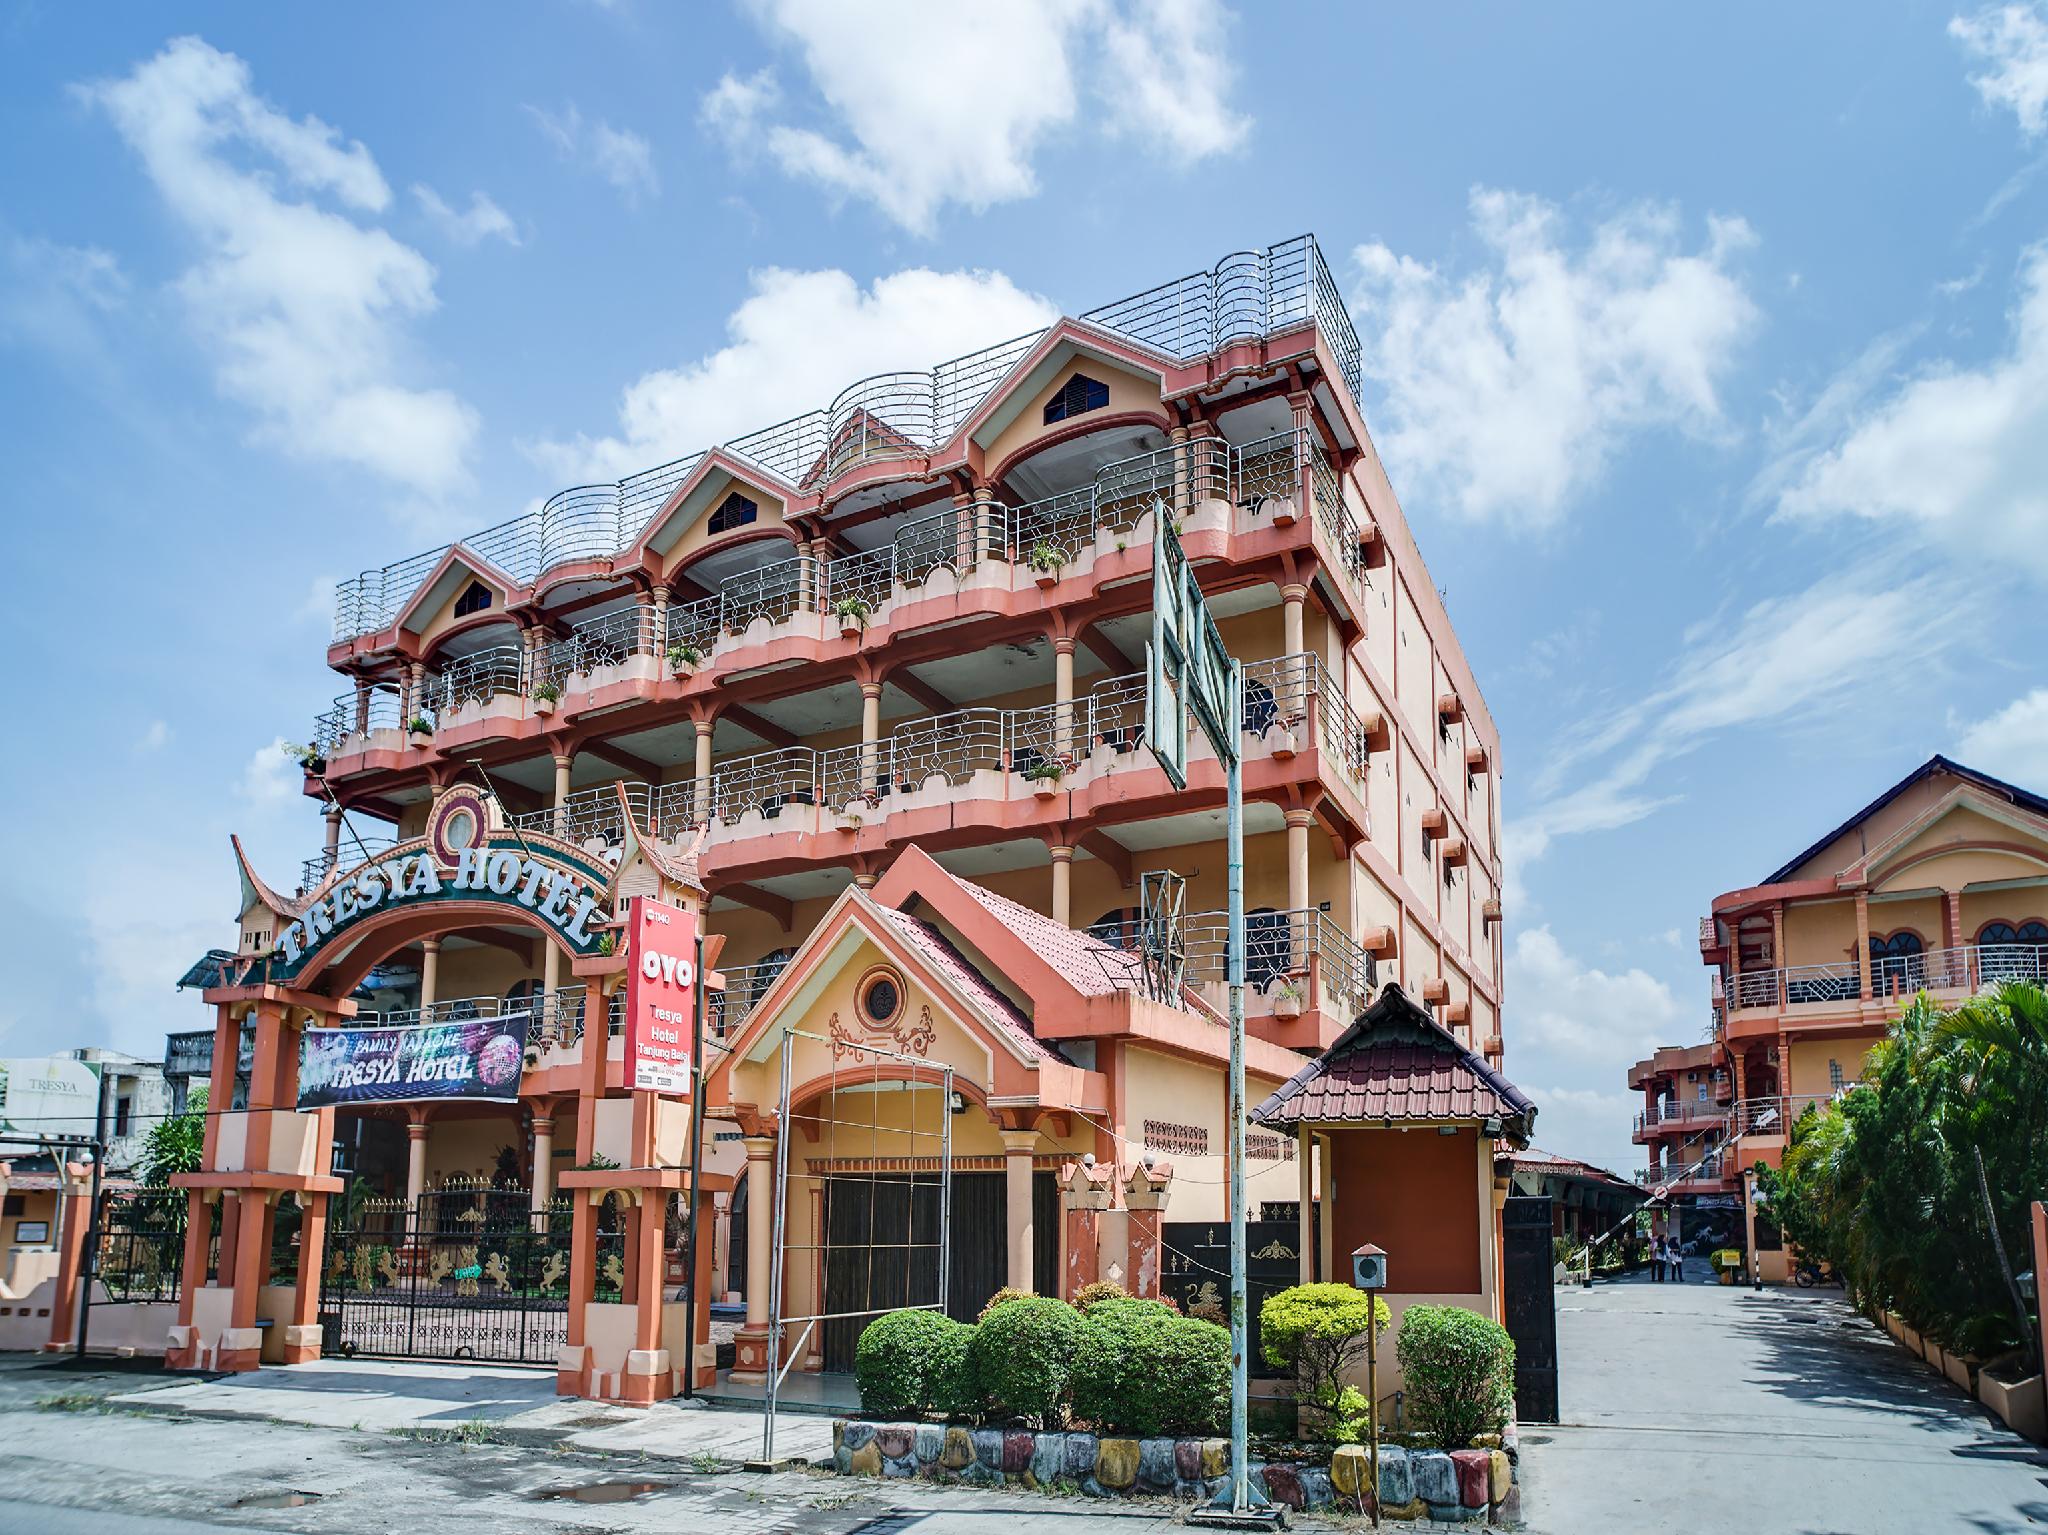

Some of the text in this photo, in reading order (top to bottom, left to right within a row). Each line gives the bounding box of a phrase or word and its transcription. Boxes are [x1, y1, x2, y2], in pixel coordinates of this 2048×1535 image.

[275, 848, 598, 967] TRESYA HOTEL
[653, 911, 670, 924] 1140
[643, 950, 693, 987] OYO
[649, 1004, 682, 1025] Tresya
[354, 1033, 462, 1053] FAMILY KARAOKE
[651, 1026, 679, 1044] Hotel
[639, 1043, 670, 1061] Tanjung
[331, 1055, 474, 1089] TRESYA HOTEL
[29, 1079, 77, 1093] TRESYA
